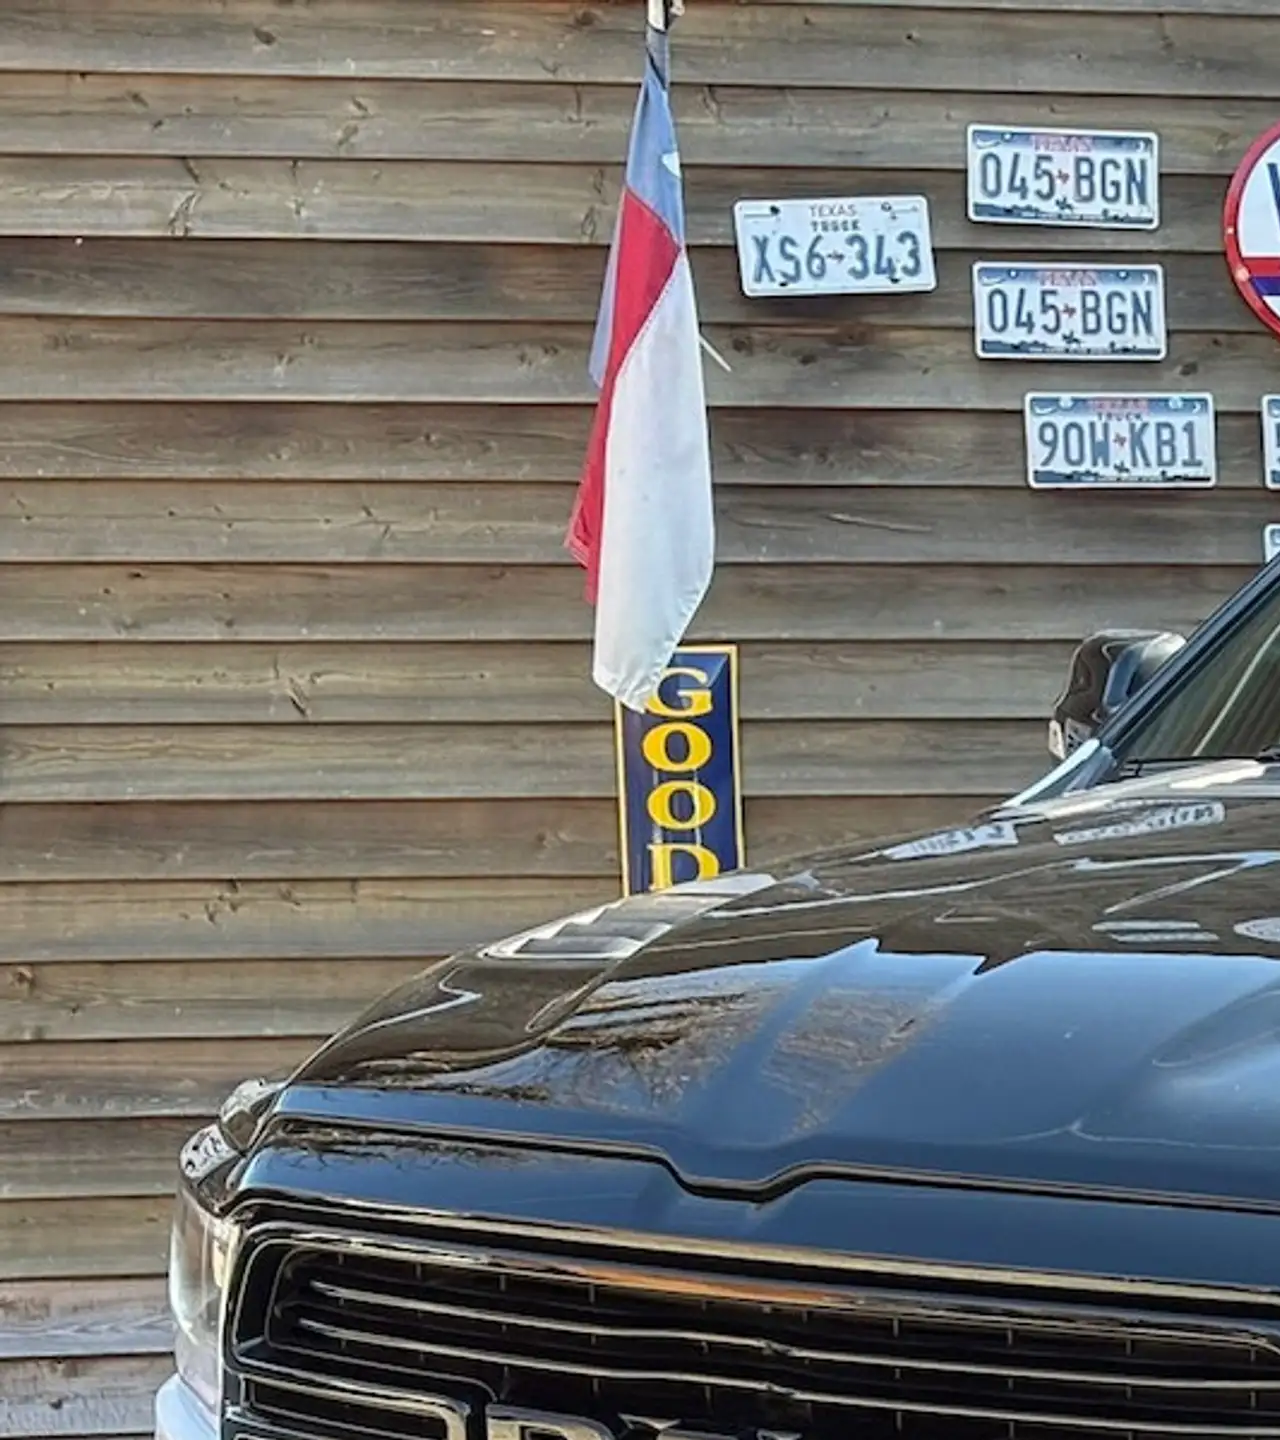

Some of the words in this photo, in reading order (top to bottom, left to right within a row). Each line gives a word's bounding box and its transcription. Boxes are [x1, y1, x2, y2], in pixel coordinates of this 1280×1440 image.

[1074, 156, 1149, 206] BGN
[809, 203, 858, 218] TEXAS
[752, 234, 827, 284] XS6
[845, 230, 922, 280] 343
[1080, 289, 1154, 338] BGN
[1128, 420, 1204, 468] KB1
[642, 666, 721, 892] GOOD
